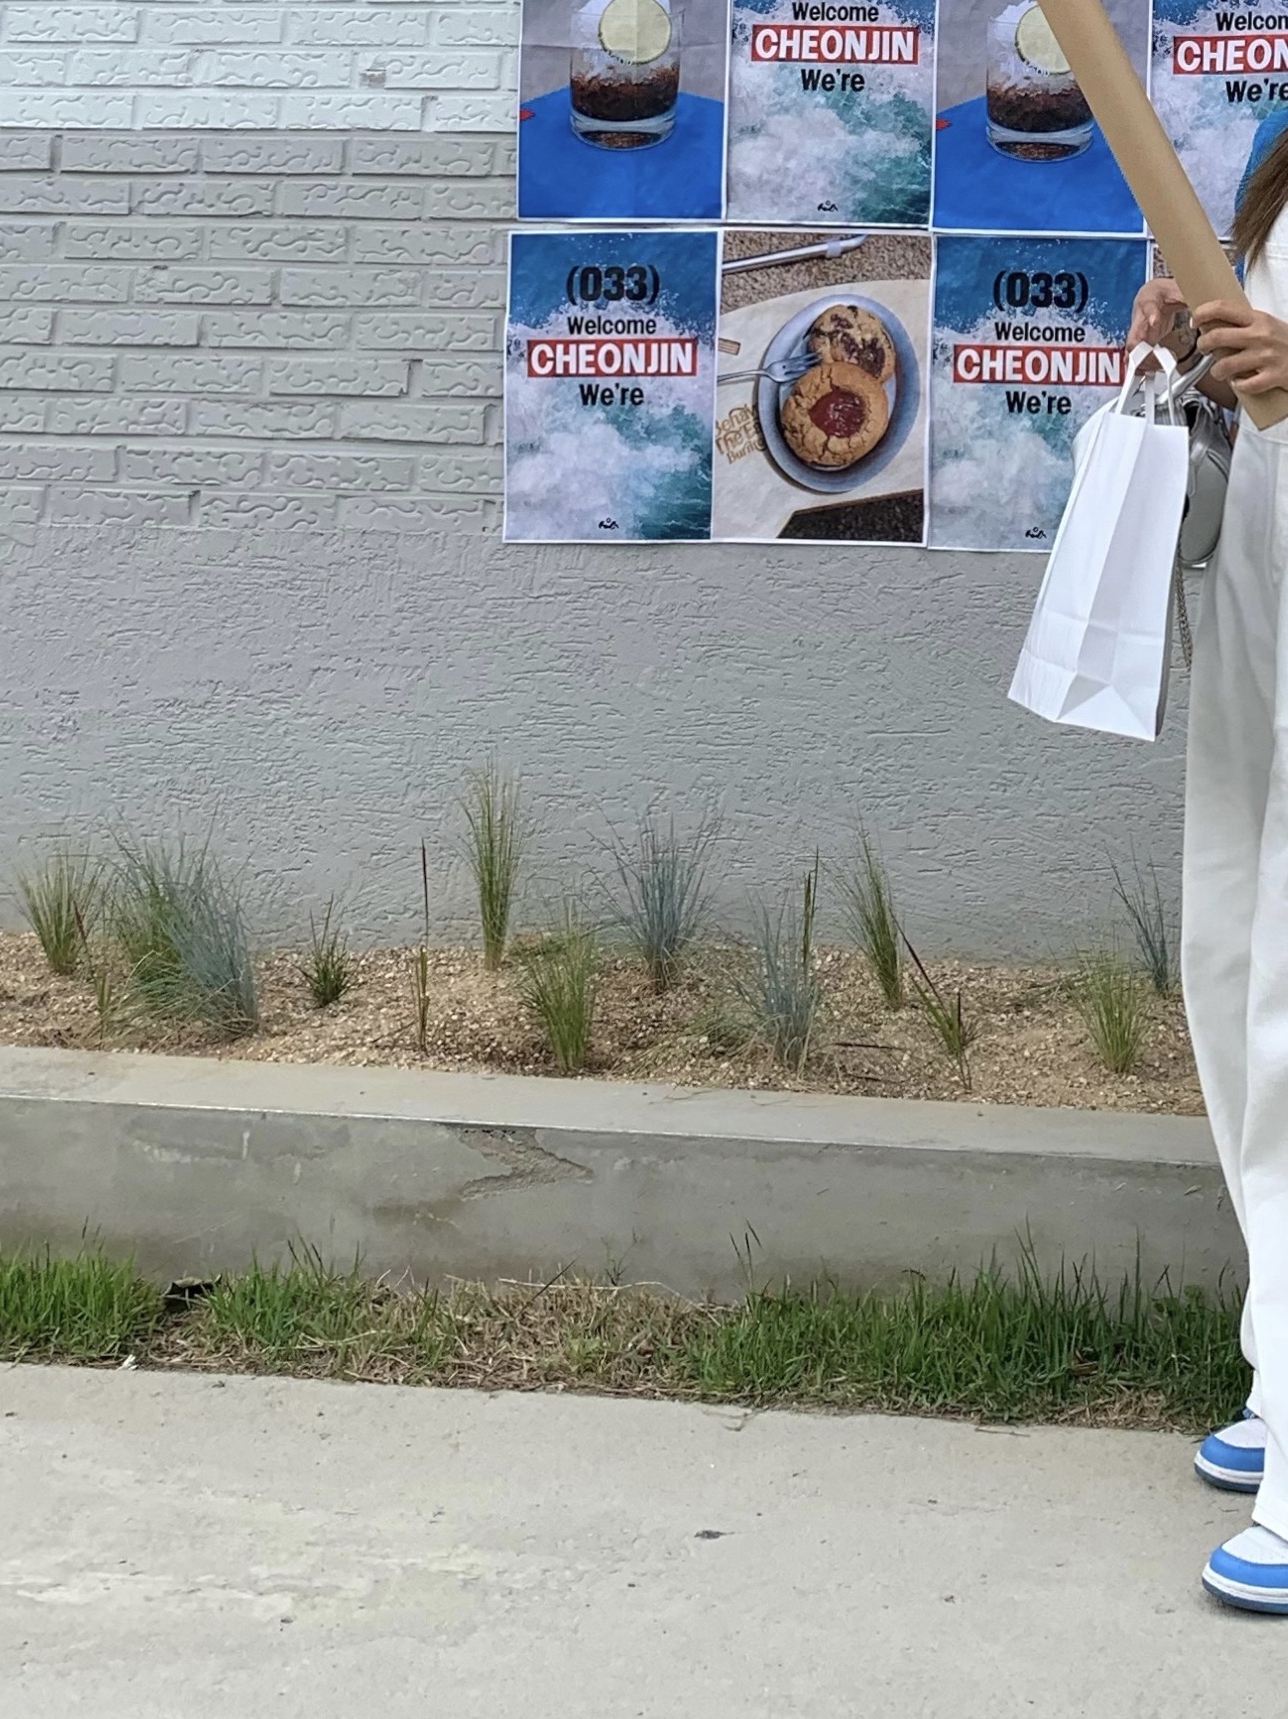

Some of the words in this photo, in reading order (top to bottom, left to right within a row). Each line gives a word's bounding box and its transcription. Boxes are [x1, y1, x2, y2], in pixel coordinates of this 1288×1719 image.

[792, 2, 879, 22] Welcome
[755, 28, 914, 61] CHEONJIN
[801, 68, 865, 92] We're
[566, 265, 660, 305] (033)
[993, 270, 1089, 313] (033)
[567, 316, 656, 335] Welcome
[994, 322, 1085, 342] Welcome
[531, 343, 692, 375] CHEONJIN
[957, 348, 1120, 383] CHEONJIN
[579, 383, 644, 406] We're
[1005, 391, 1072, 414] We're
